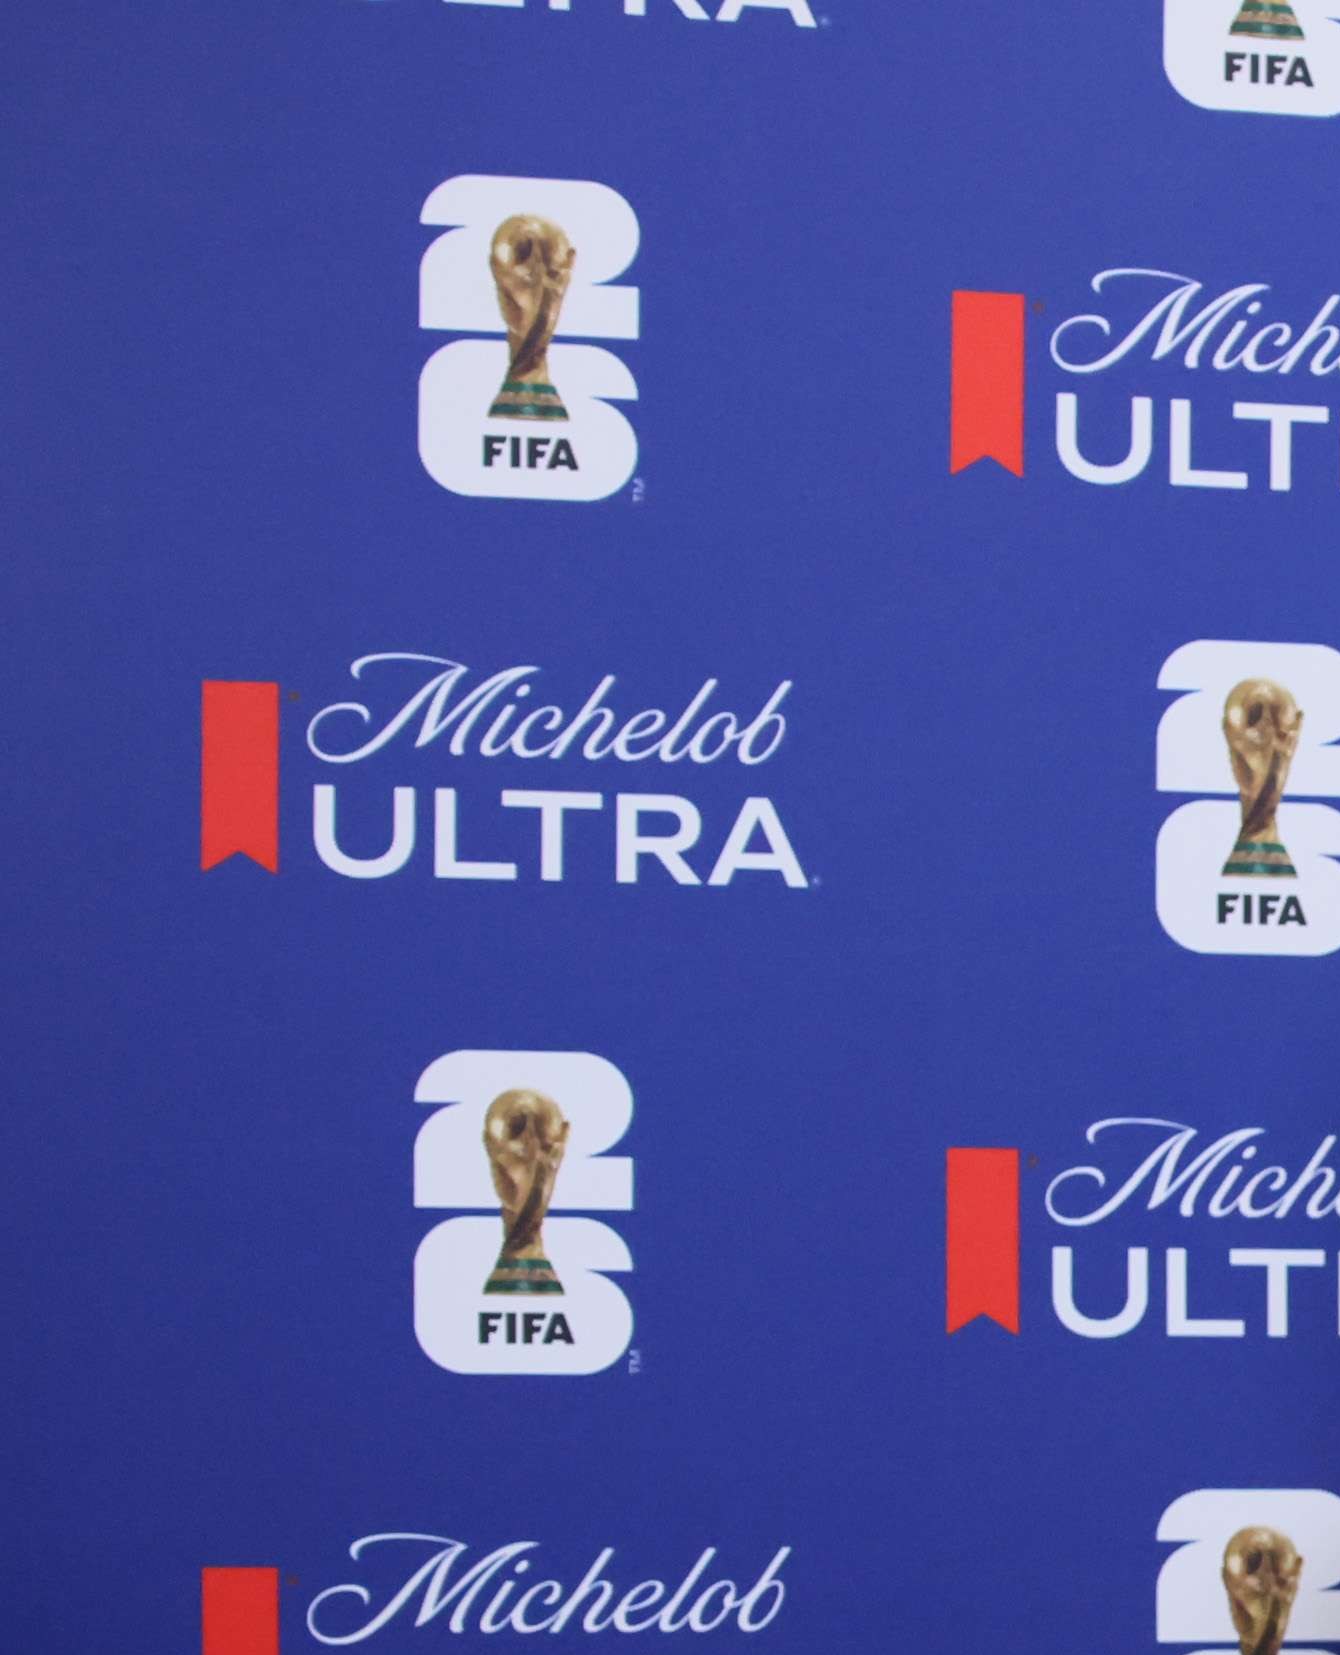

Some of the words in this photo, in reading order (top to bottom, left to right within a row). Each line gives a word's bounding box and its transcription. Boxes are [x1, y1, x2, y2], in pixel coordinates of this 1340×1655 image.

[1225, 52, 1313, 87] FIFA
[484, 436, 578, 470] FIFA
[307, 653, 792, 765] Michelob
[314, 785, 808, 888] ULTRA
[1218, 894, 1306, 925] FIFA
[479, 1313, 574, 1344] FIFA
[307, 1533, 791, 1645] Michelob
